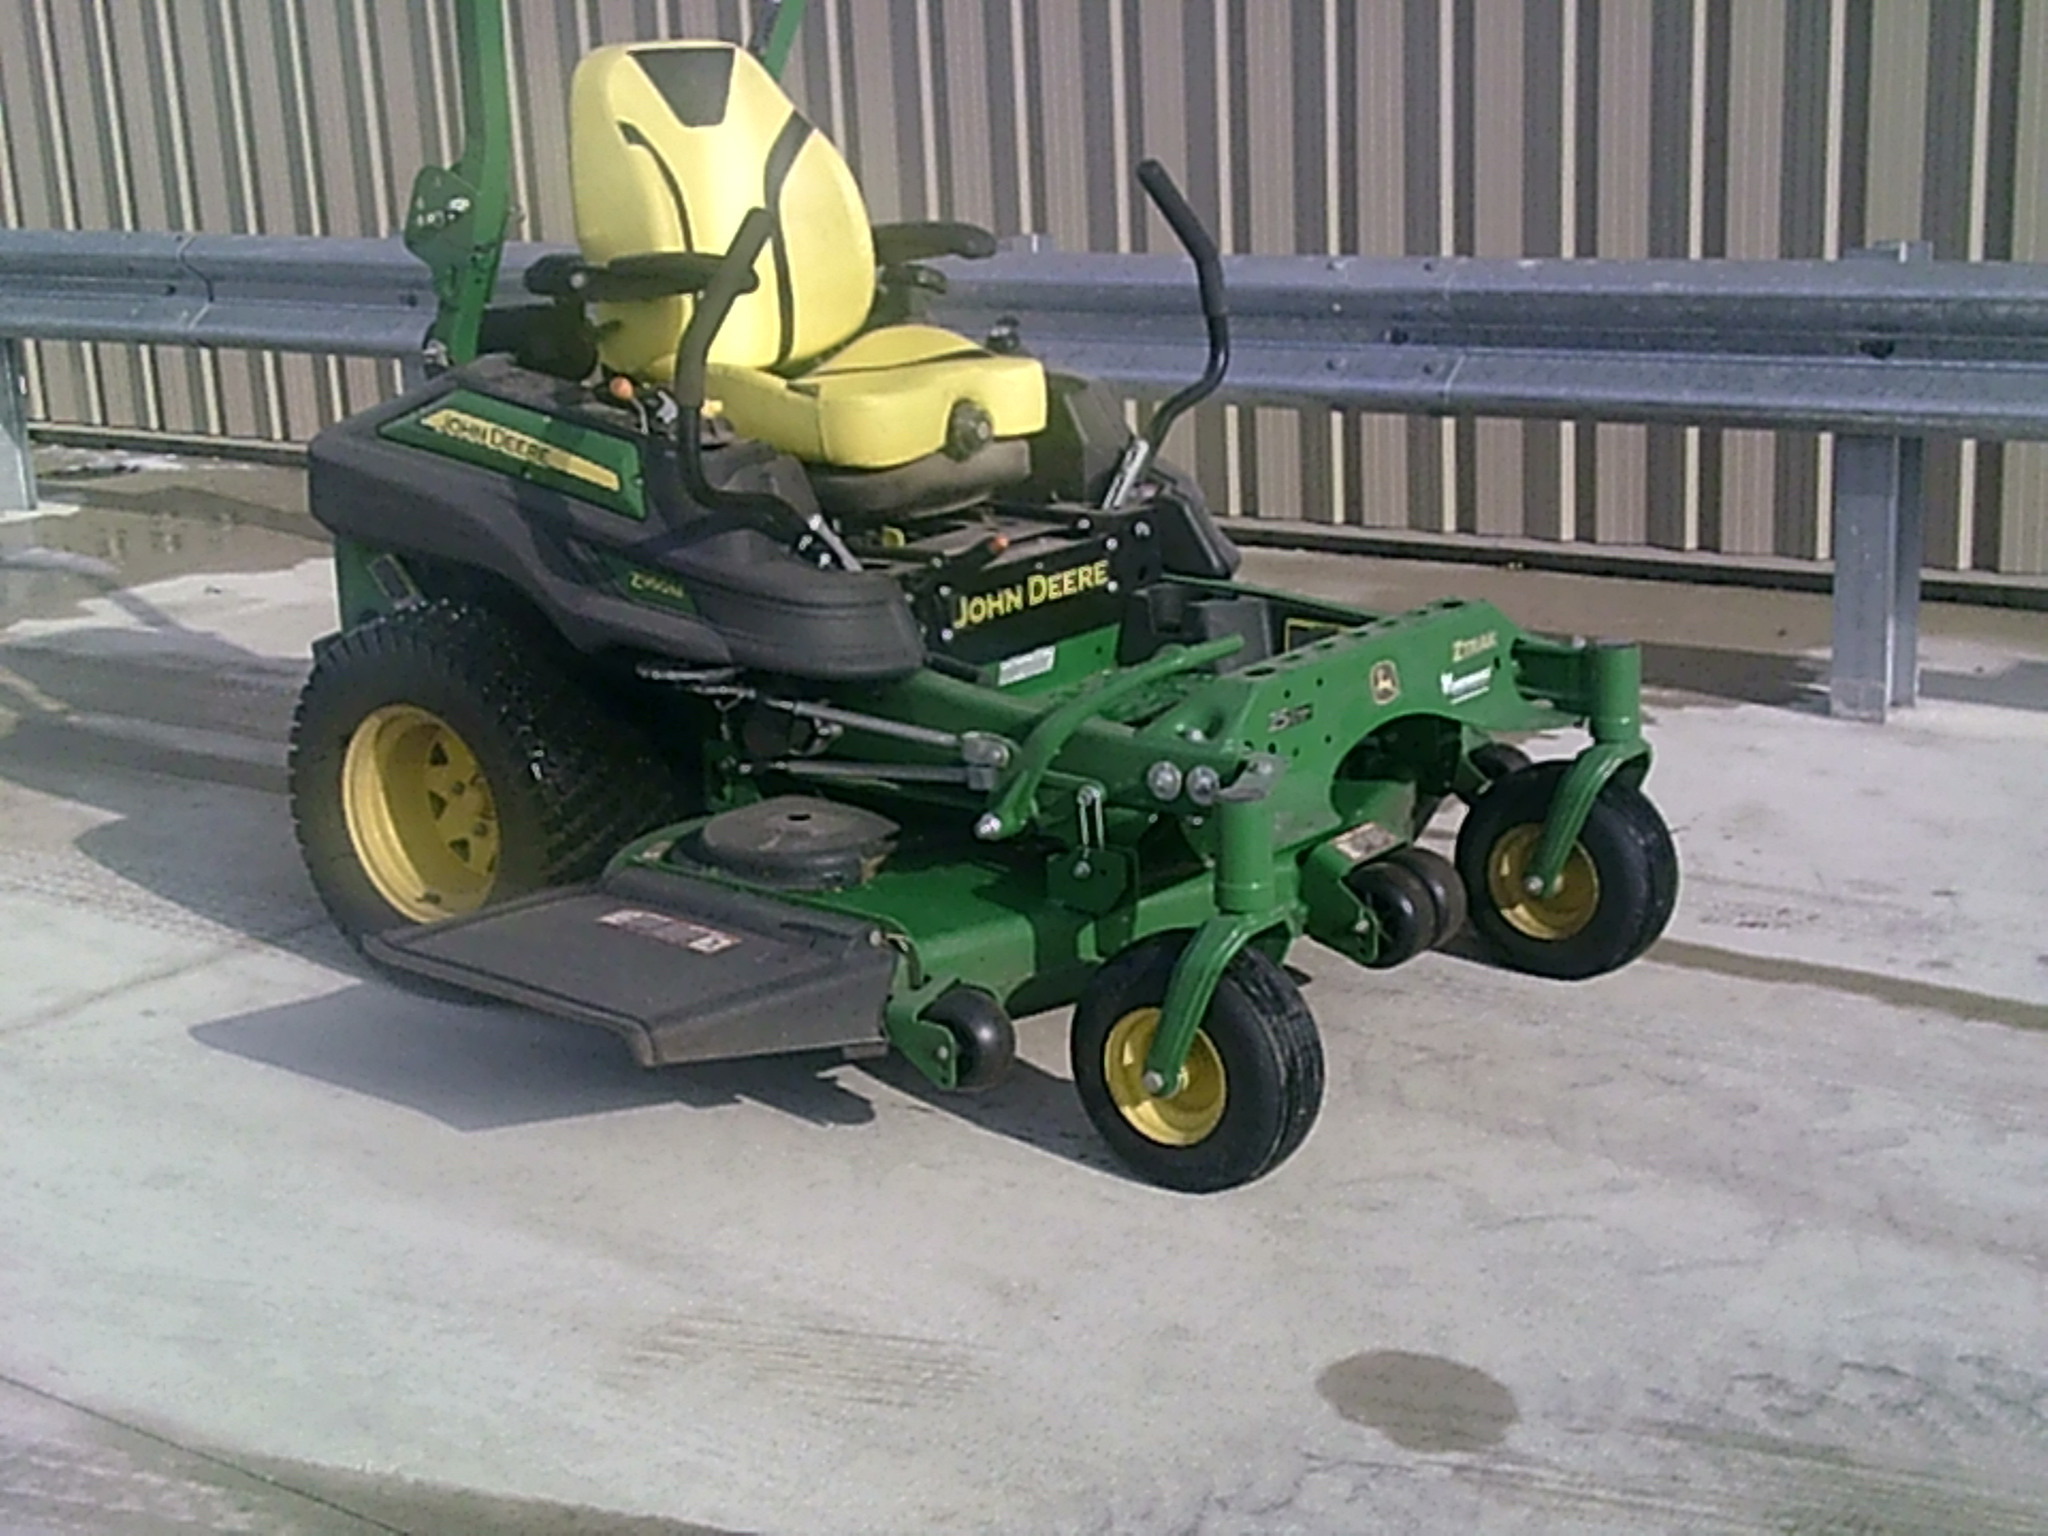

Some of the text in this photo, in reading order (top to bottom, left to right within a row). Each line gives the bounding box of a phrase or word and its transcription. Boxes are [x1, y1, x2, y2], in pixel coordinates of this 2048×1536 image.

[442, 413, 549, 465] JOHN DEERE
[953, 559, 1109, 629] JOHN DEERE
